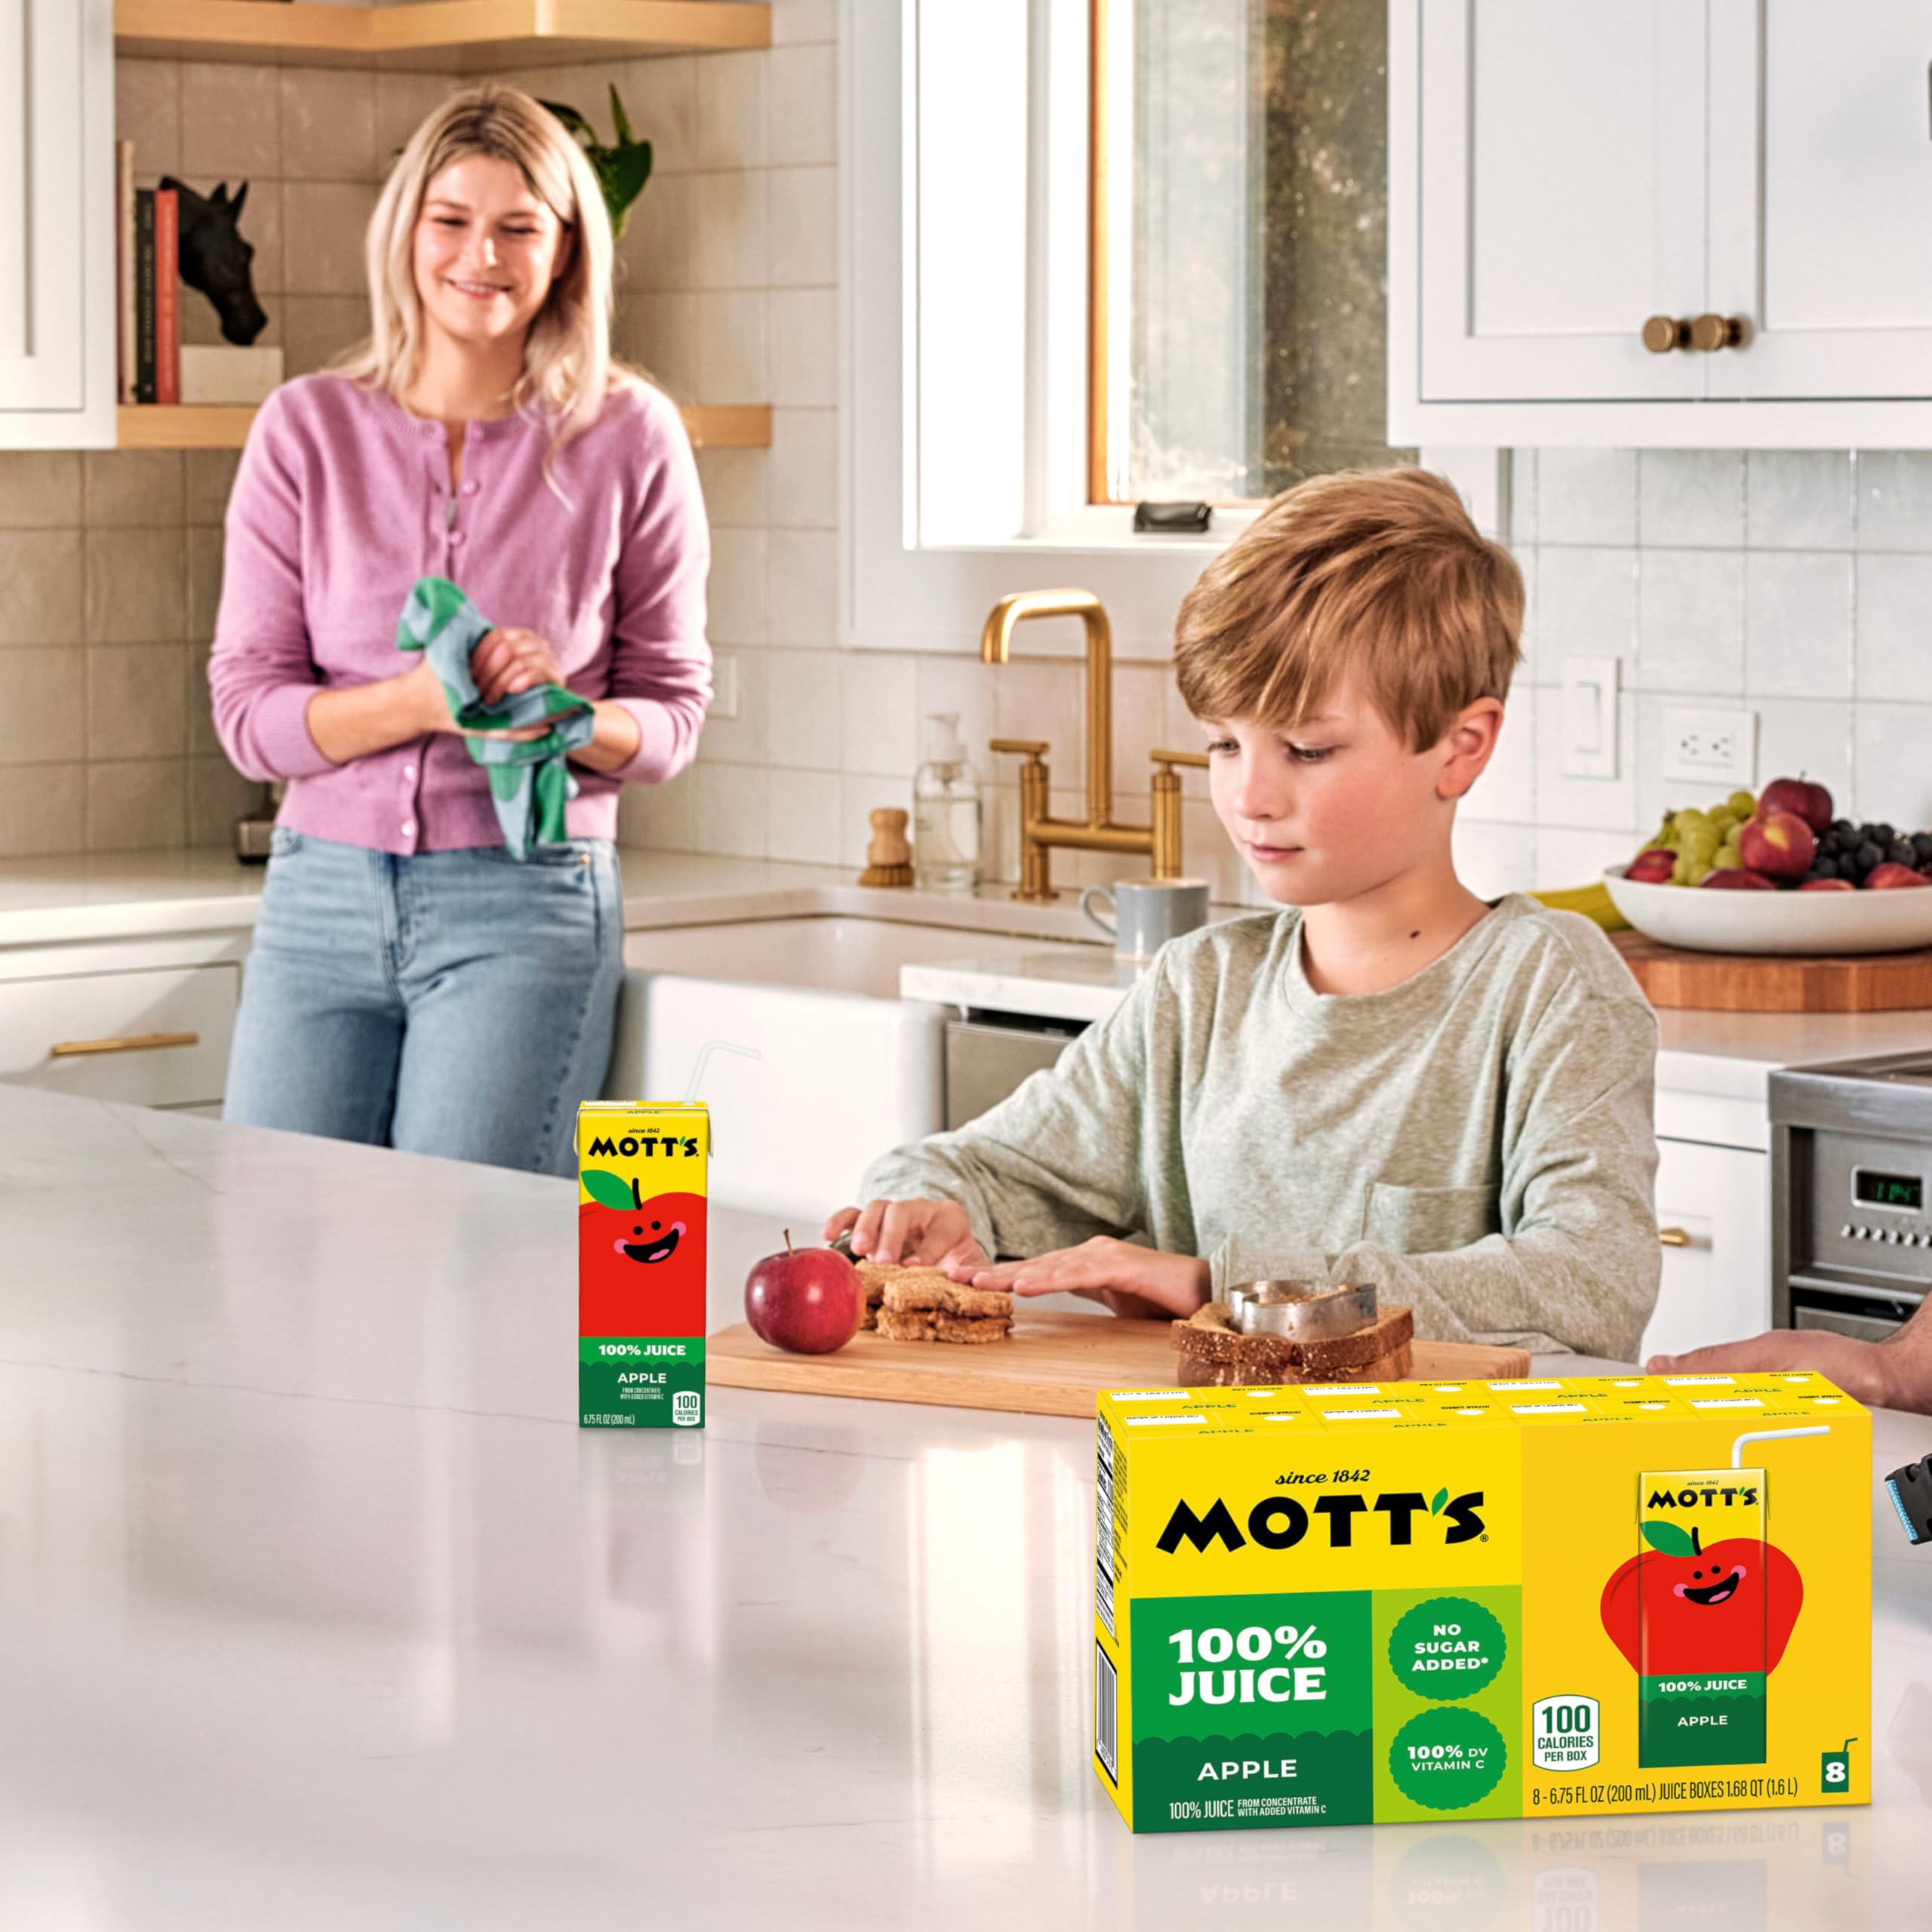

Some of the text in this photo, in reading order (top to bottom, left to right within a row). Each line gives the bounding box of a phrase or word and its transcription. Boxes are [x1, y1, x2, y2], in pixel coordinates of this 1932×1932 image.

[588, 1136, 700, 1158] MOTT'S
[599, 1345, 685, 1355] 100% JUICE
[618, 1373, 666, 1383] APPLE
[1275, 1469, 1370, 1484] since 1842
[1647, 1487, 1758, 1509] MOTT'S
[1155, 1486, 1489, 1555] MOTT'S
[1434, 1624, 1461, 1635] NO
[1169, 1625, 1327, 1663] 100%
[1415, 1641, 1479, 1654] SUGAR
[1169, 1667, 1326, 1706] JUICE
[1659, 1680, 1746, 1692] 100% JUICE
[1542, 1705, 1590, 1734] 100
[1678, 1715, 1727, 1726] APPLE
[1538, 1736, 1593, 1749] CALORIES
[1407, 1745, 1487, 1760] 100% DV
[1545, 1751, 1586, 1761] PER BOX
[1198, 1759, 1297, 1780] APPLE
[1411, 1760, 1484, 1770] VITAMIN C
[1826, 1762, 1845, 1782] 8
[1534, 1789, 1540, 1804] 8
[1550, 1787, 1573, 1804] 6.75
[1576, 1786, 1588, 1803] FL
[1591, 1786, 1604, 1802] OZ
[1607, 1785, 1632, 1804] (200
[1635, 1783, 1656, 1802] mL)
[1659, 1783, 1686, 1800] JUICE
[1690, 1781, 1724, 1798] BOXES
[1727, 1780, 1747, 1797] 1.68
[1751, 1780, 1764, 1797] QT
[1767, 1778, 1784, 1798] (1.6
[1788, 1777, 1798, 1797] L)
[1238, 1796, 1317, 1807] FROM CONCENTRATE
[1170, 1800, 1234, 1819] 100% JUICE
[1238, 1804, 1326, 1817] WITH ADDED VITAMIN C
